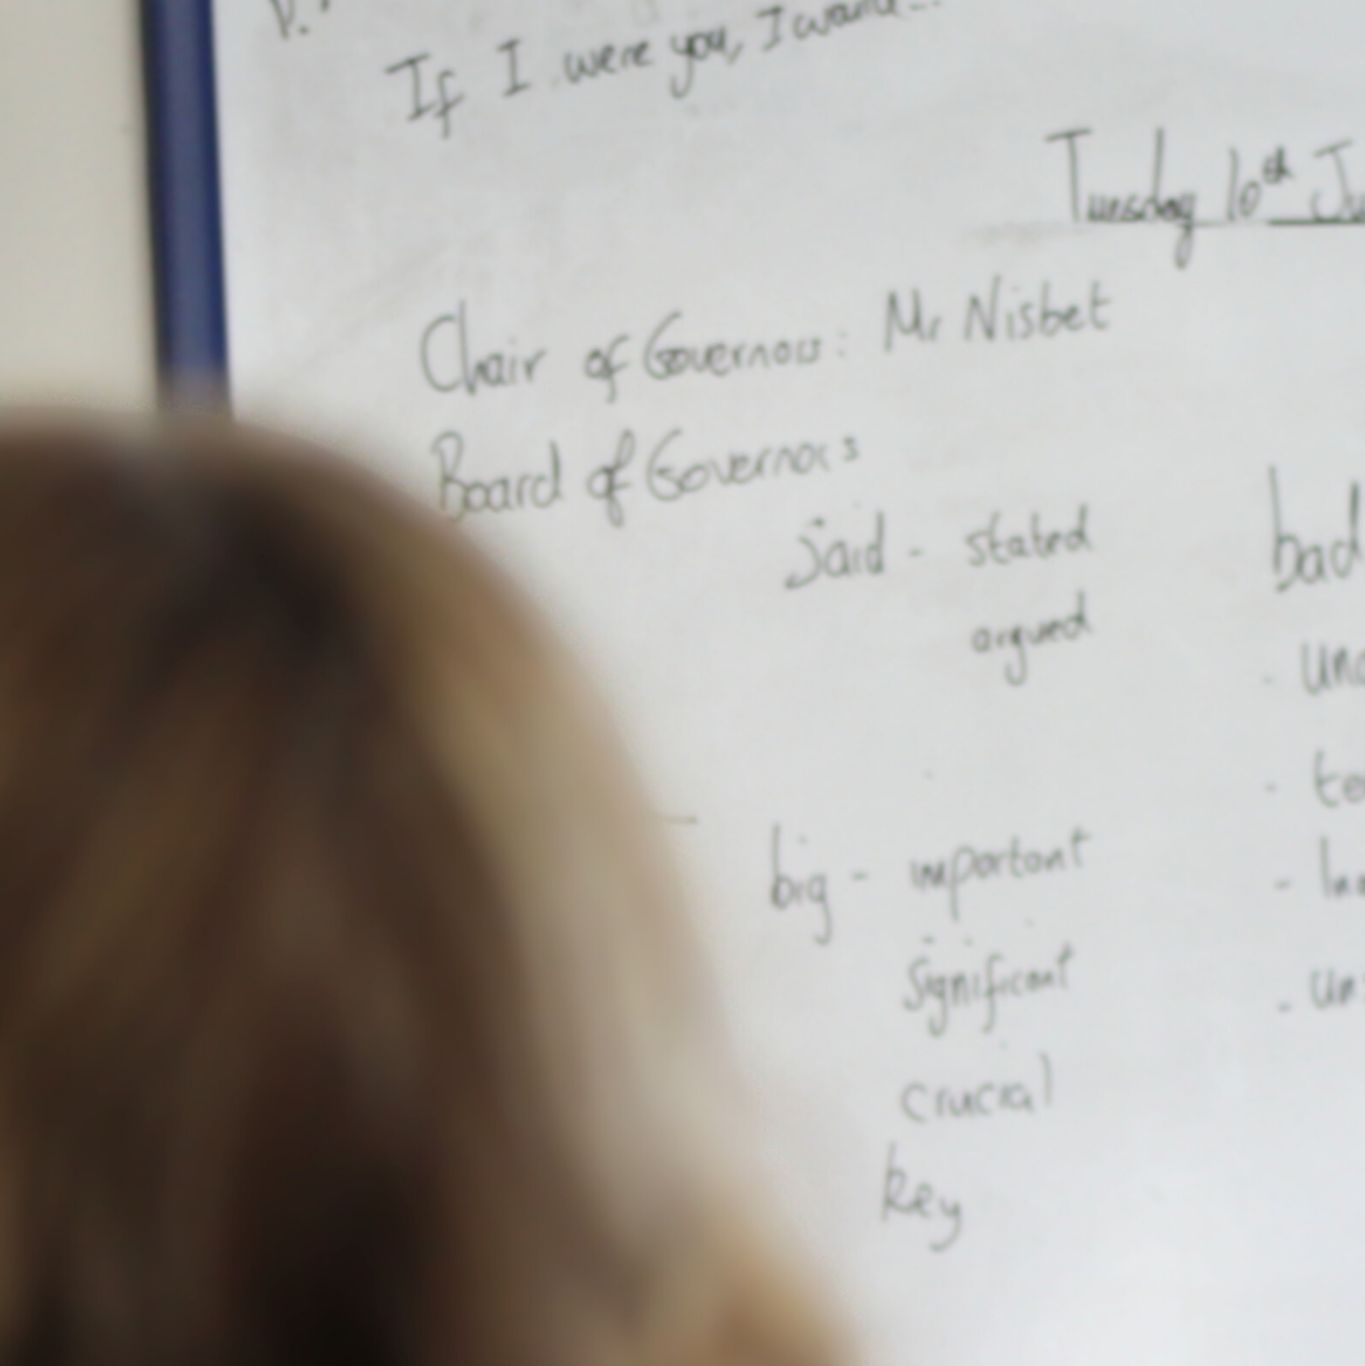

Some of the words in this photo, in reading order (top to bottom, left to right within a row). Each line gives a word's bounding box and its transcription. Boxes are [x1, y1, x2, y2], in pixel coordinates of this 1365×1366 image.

[384, 52, 466, 139] If
[496, 38, 530, 97] I
[562, 38, 656, 84] were
[756, 4, 785, 52] I
[1045, 126, 1200, 270] Tuesday
[420, 298, 547, 397] Chair
[582, 332, 630, 403] of
[883, 286, 943, 352] Mr
[963, 272, 1113, 343] Nisbet
[431, 430, 564, 522] Board
[586, 428, 636, 530] of
[644, 427, 861, 503] Governors
[964, 502, 1094, 568] stated
[1266, 463, 1364, 594] bad
[969, 588, 1094, 688] argued
[768, 823, 834, 946] big
[909, 825, 1092, 922] important
